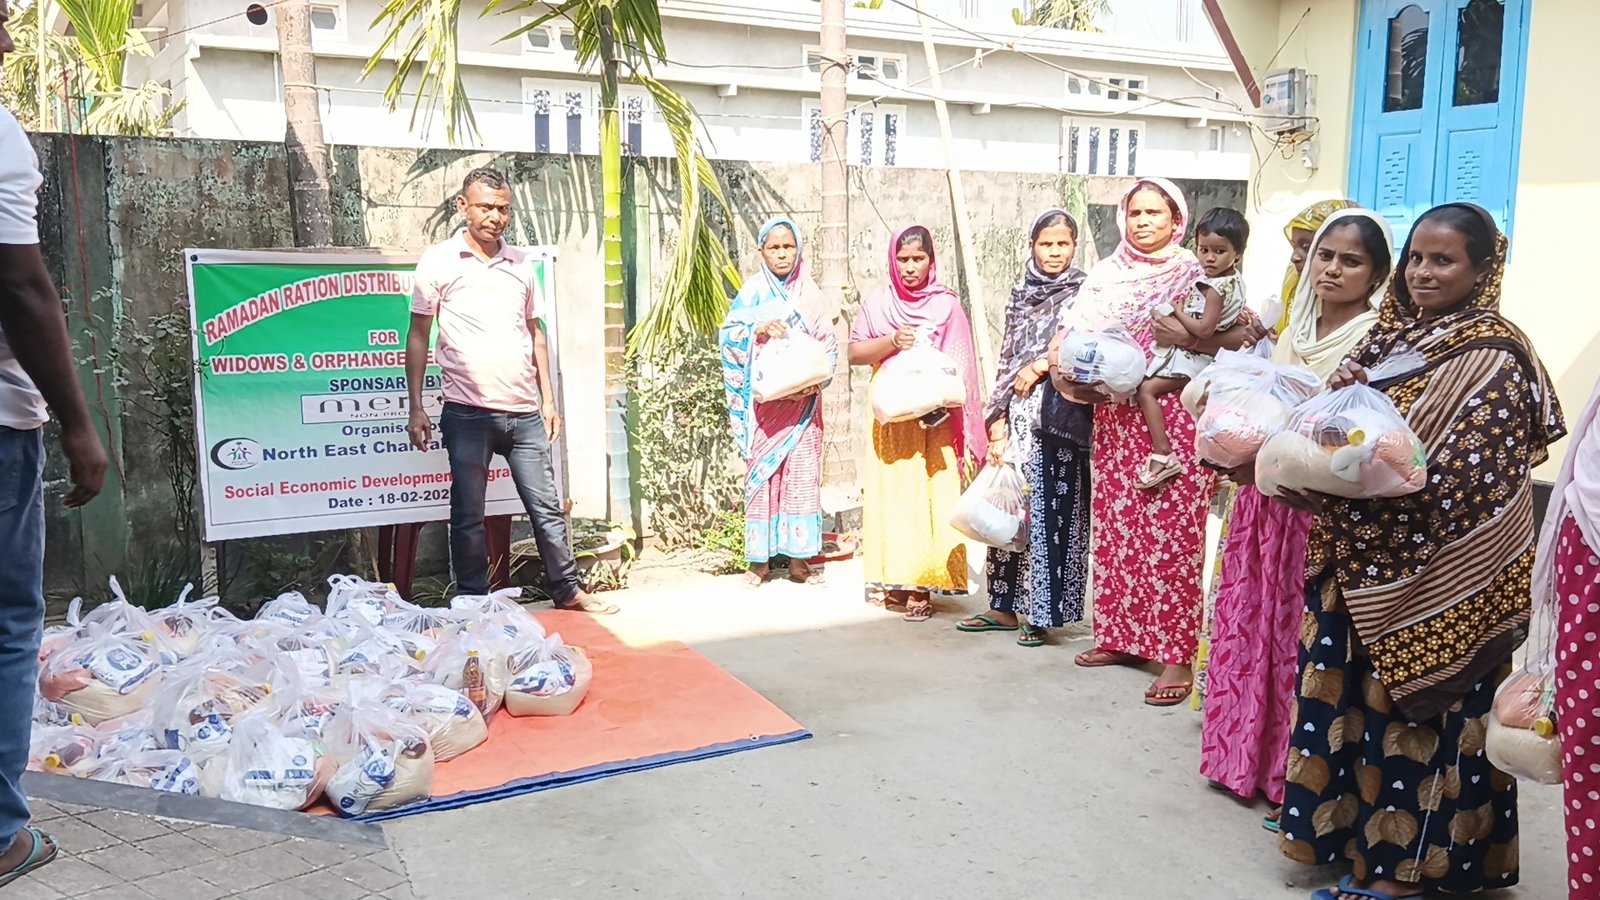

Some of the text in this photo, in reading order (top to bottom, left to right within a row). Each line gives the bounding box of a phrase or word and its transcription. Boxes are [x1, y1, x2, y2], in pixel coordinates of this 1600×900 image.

[205, 272, 412, 343] RAMADAN RATION DISTRIBU
[369, 331, 397, 343] FOR
[212, 356, 287, 372] WIDOWS
[293, 355, 305, 369] &
[329, 376, 407, 392] SPONSAR
[263, 446, 317, 461] North
[325, 443, 367, 457] East
[225, 471, 453, 499] Social Economic Developmen
[329, 497, 363, 509] Date
[379, 489, 449, 505] 18-02-202
